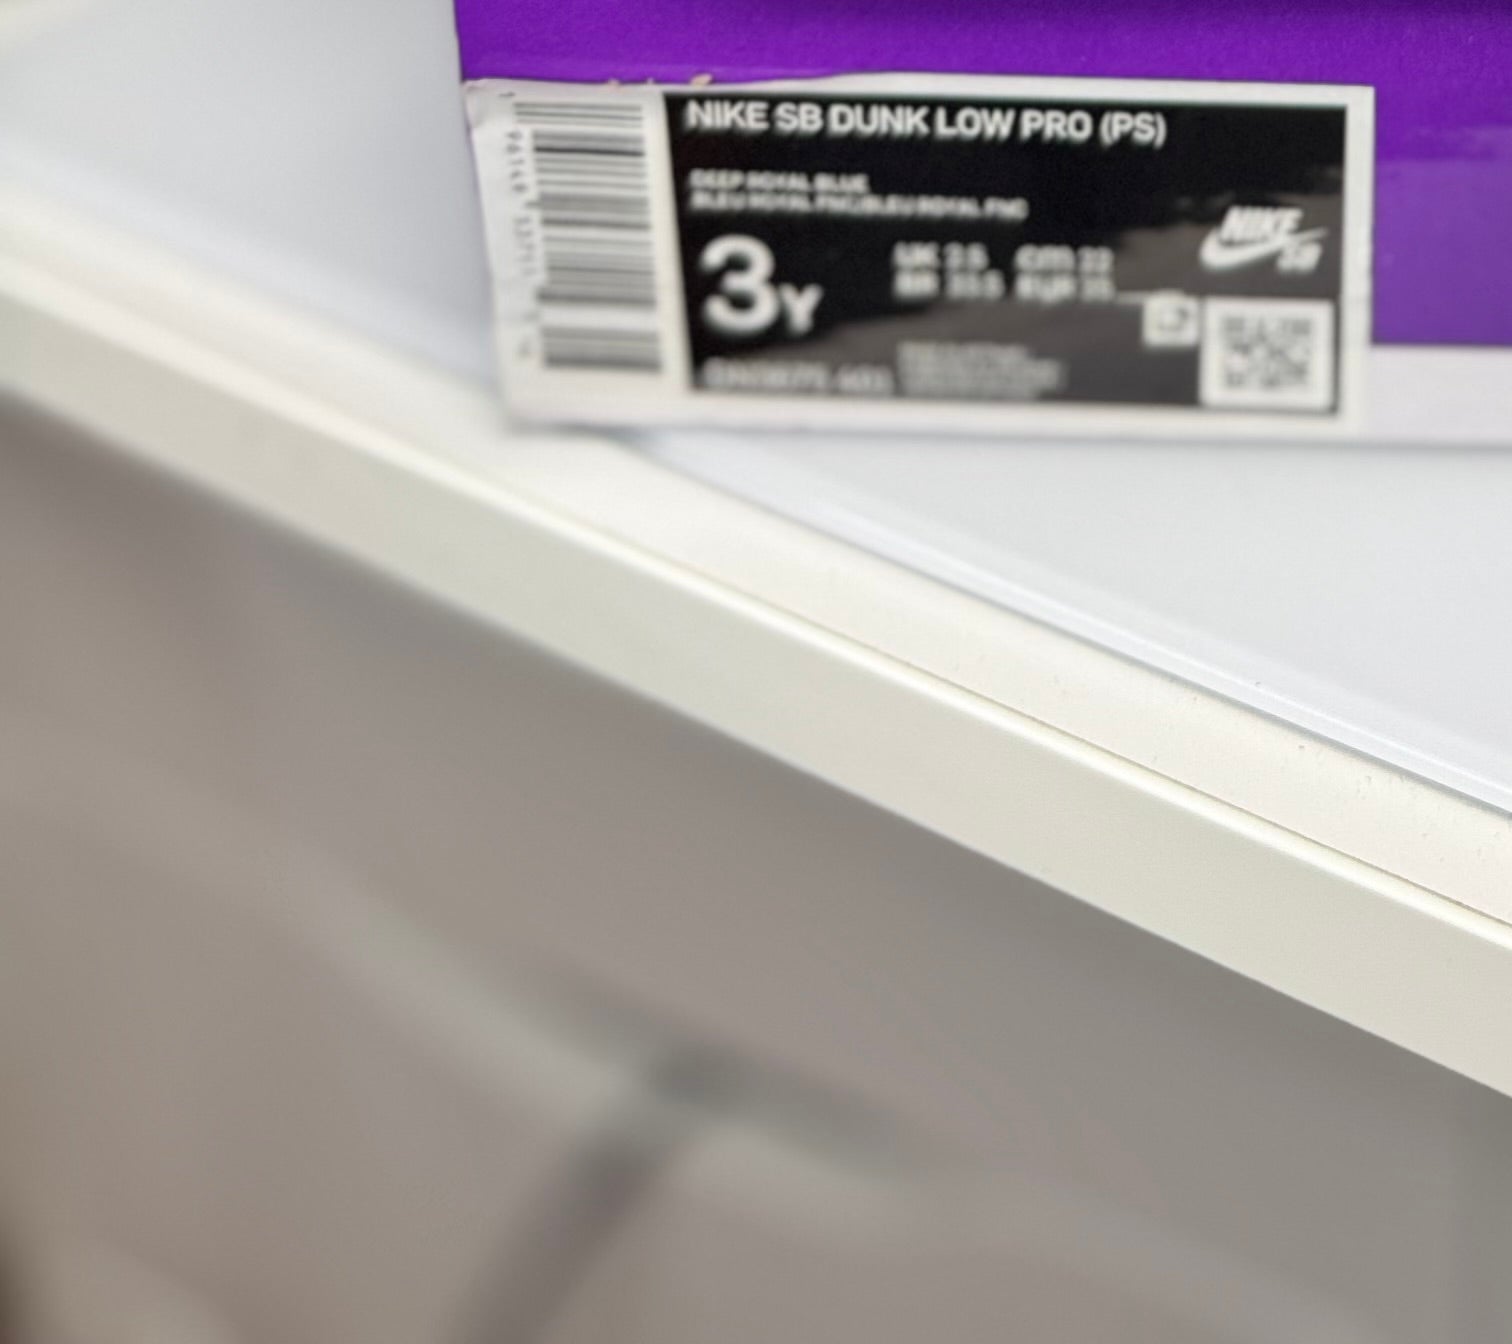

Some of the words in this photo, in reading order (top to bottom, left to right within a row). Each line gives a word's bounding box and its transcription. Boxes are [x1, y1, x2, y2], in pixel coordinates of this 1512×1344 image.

[686, 99, 770, 130] NIKE
[774, 101, 823, 132] SB
[827, 103, 930, 135] DUNK
[934, 106, 1015, 139] LOW
[1020, 110, 1093, 142] PRO
[1099, 112, 1167, 149] (PS)
[1220, 205, 1304, 243] NIKE
[700, 233, 824, 336] 3Y
